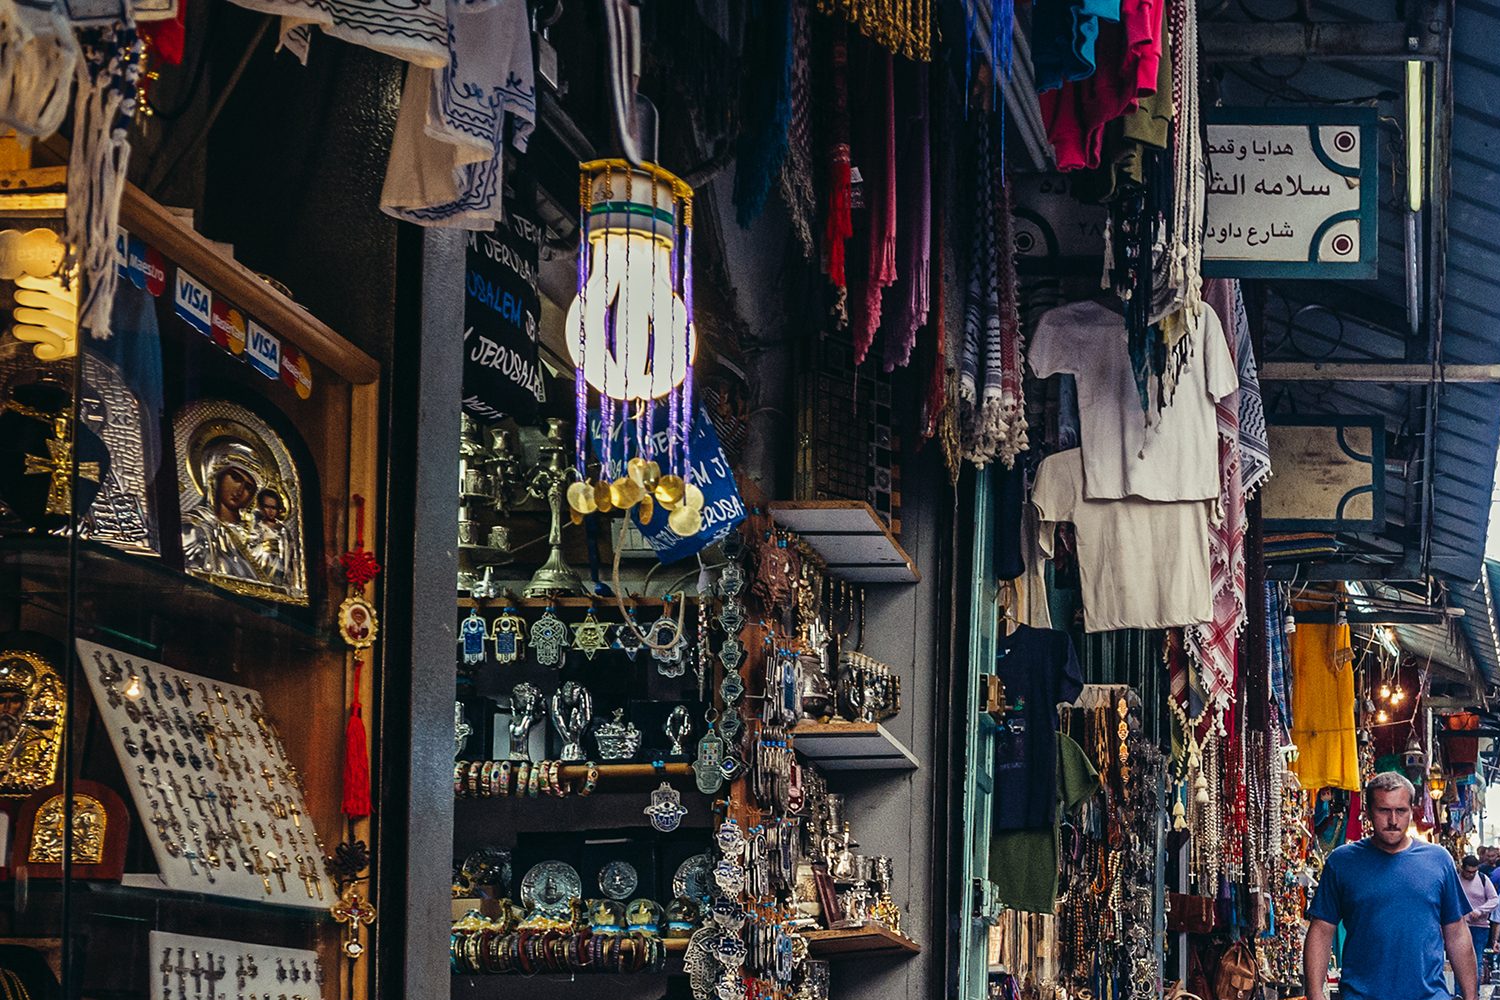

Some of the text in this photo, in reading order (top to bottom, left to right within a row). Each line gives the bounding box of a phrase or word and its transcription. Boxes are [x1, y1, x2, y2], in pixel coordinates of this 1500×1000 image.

[1253, 140, 1294, 161] هدايا
[1206, 223, 1242, 243] داود
[1246, 222, 1294, 246] شارع
[179, 280, 209, 318] VISA
[251, 331, 278, 365] VISA
